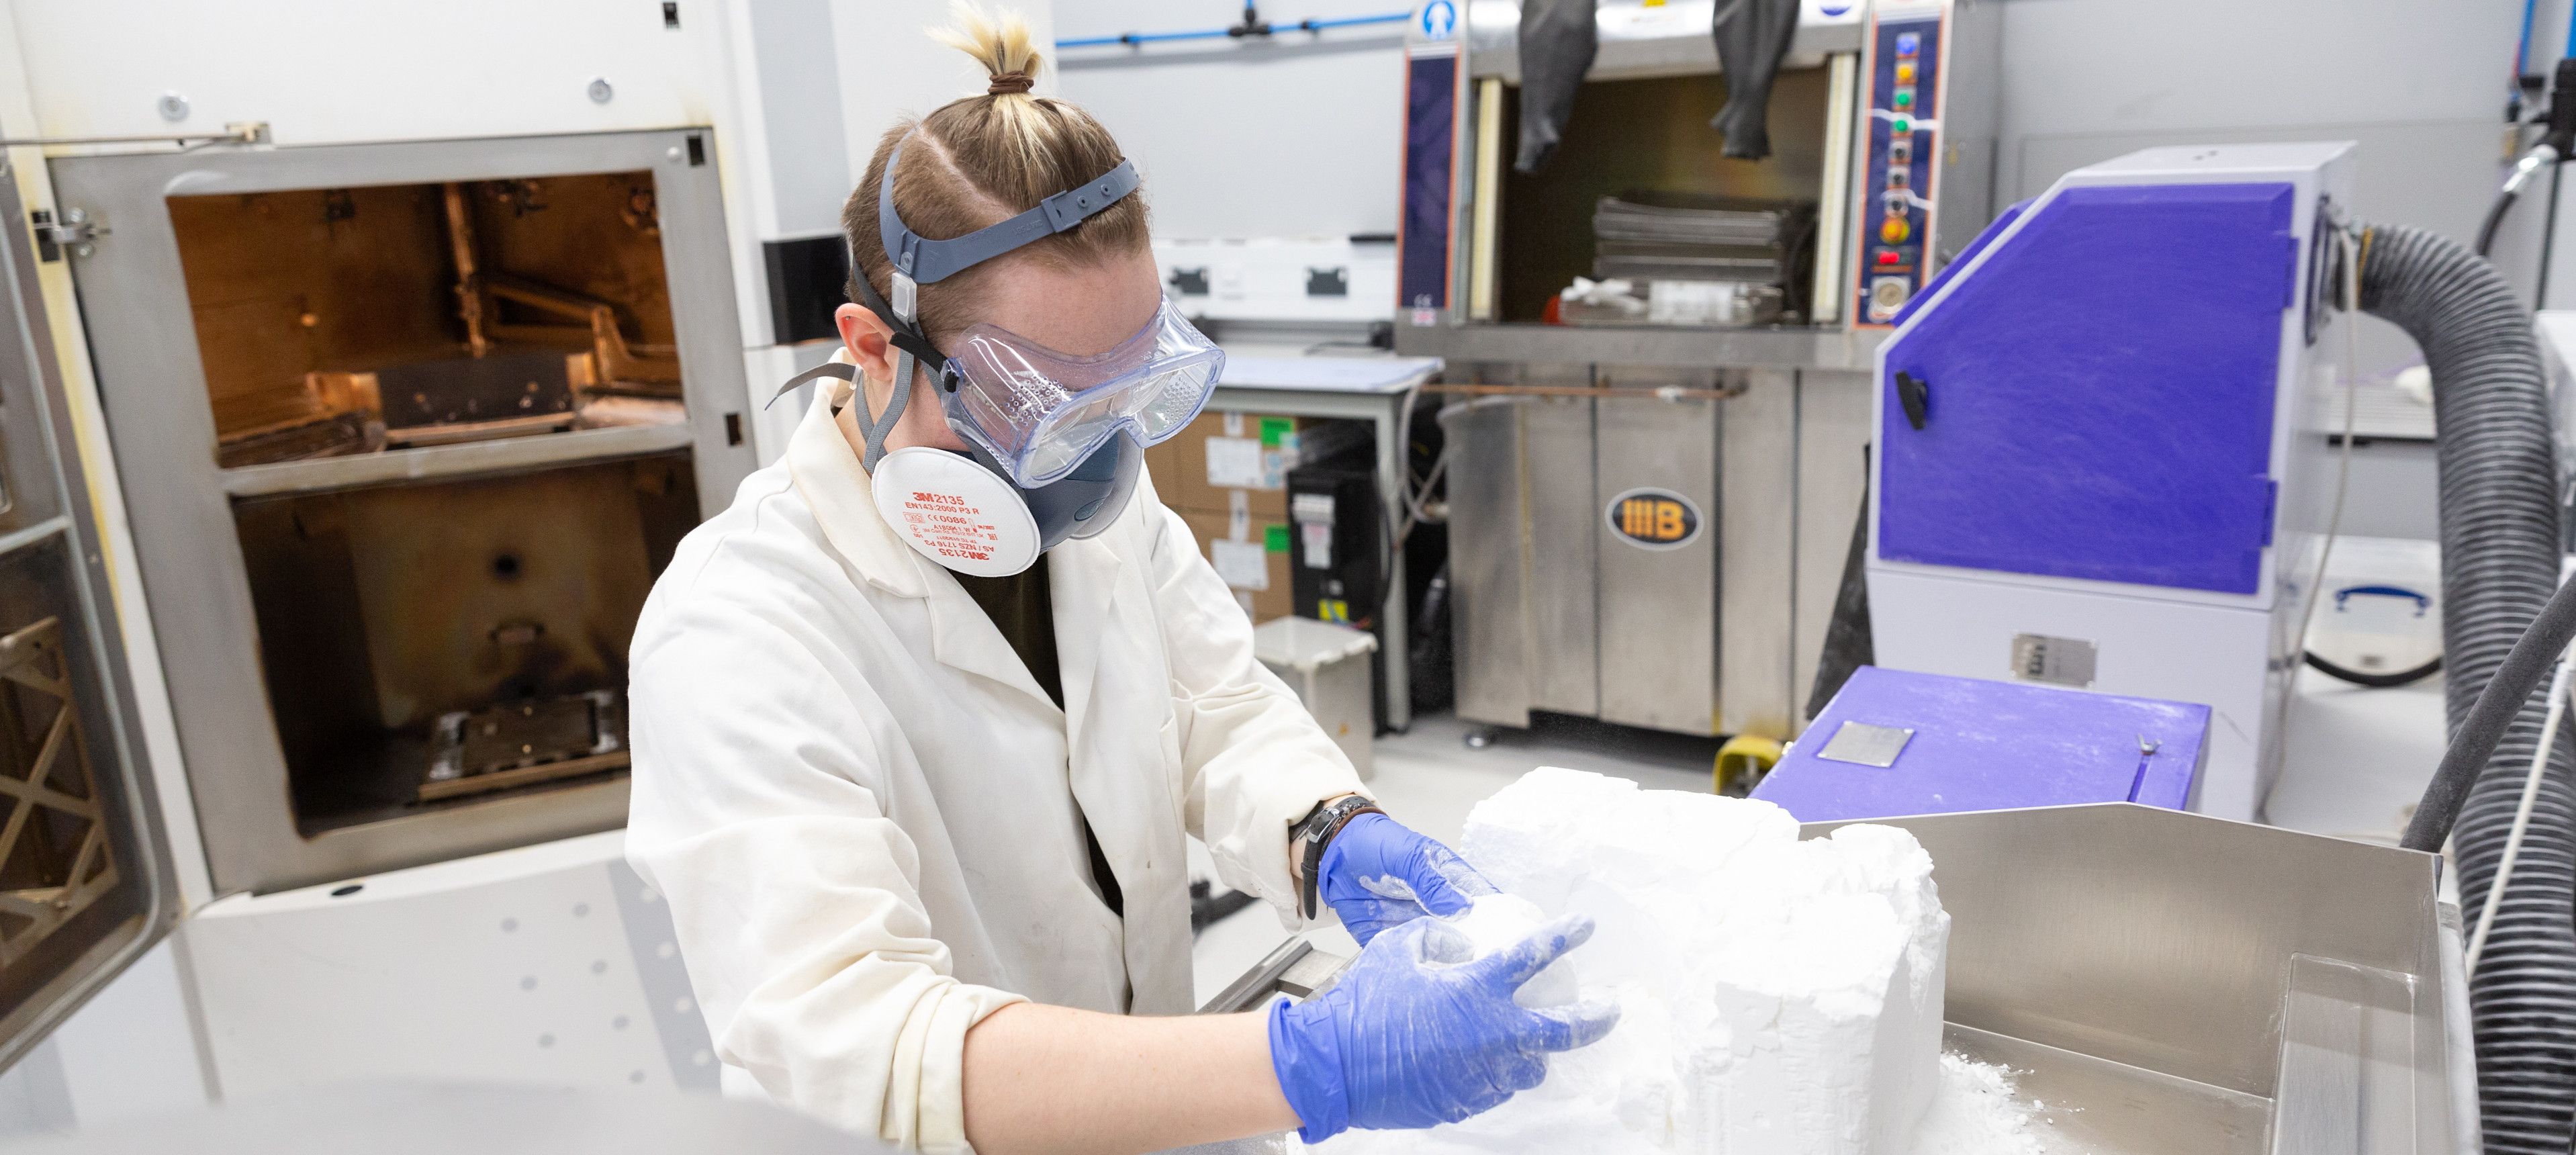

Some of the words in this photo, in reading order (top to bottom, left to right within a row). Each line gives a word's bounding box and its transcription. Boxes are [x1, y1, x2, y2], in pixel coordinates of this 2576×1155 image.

[913, 492, 934, 502] 3M
[934, 494, 964, 506] 2135
[905, 502, 957, 513] EN143:2000
[939, 516, 967, 524] 0086
[939, 548, 968, 558] 2135
